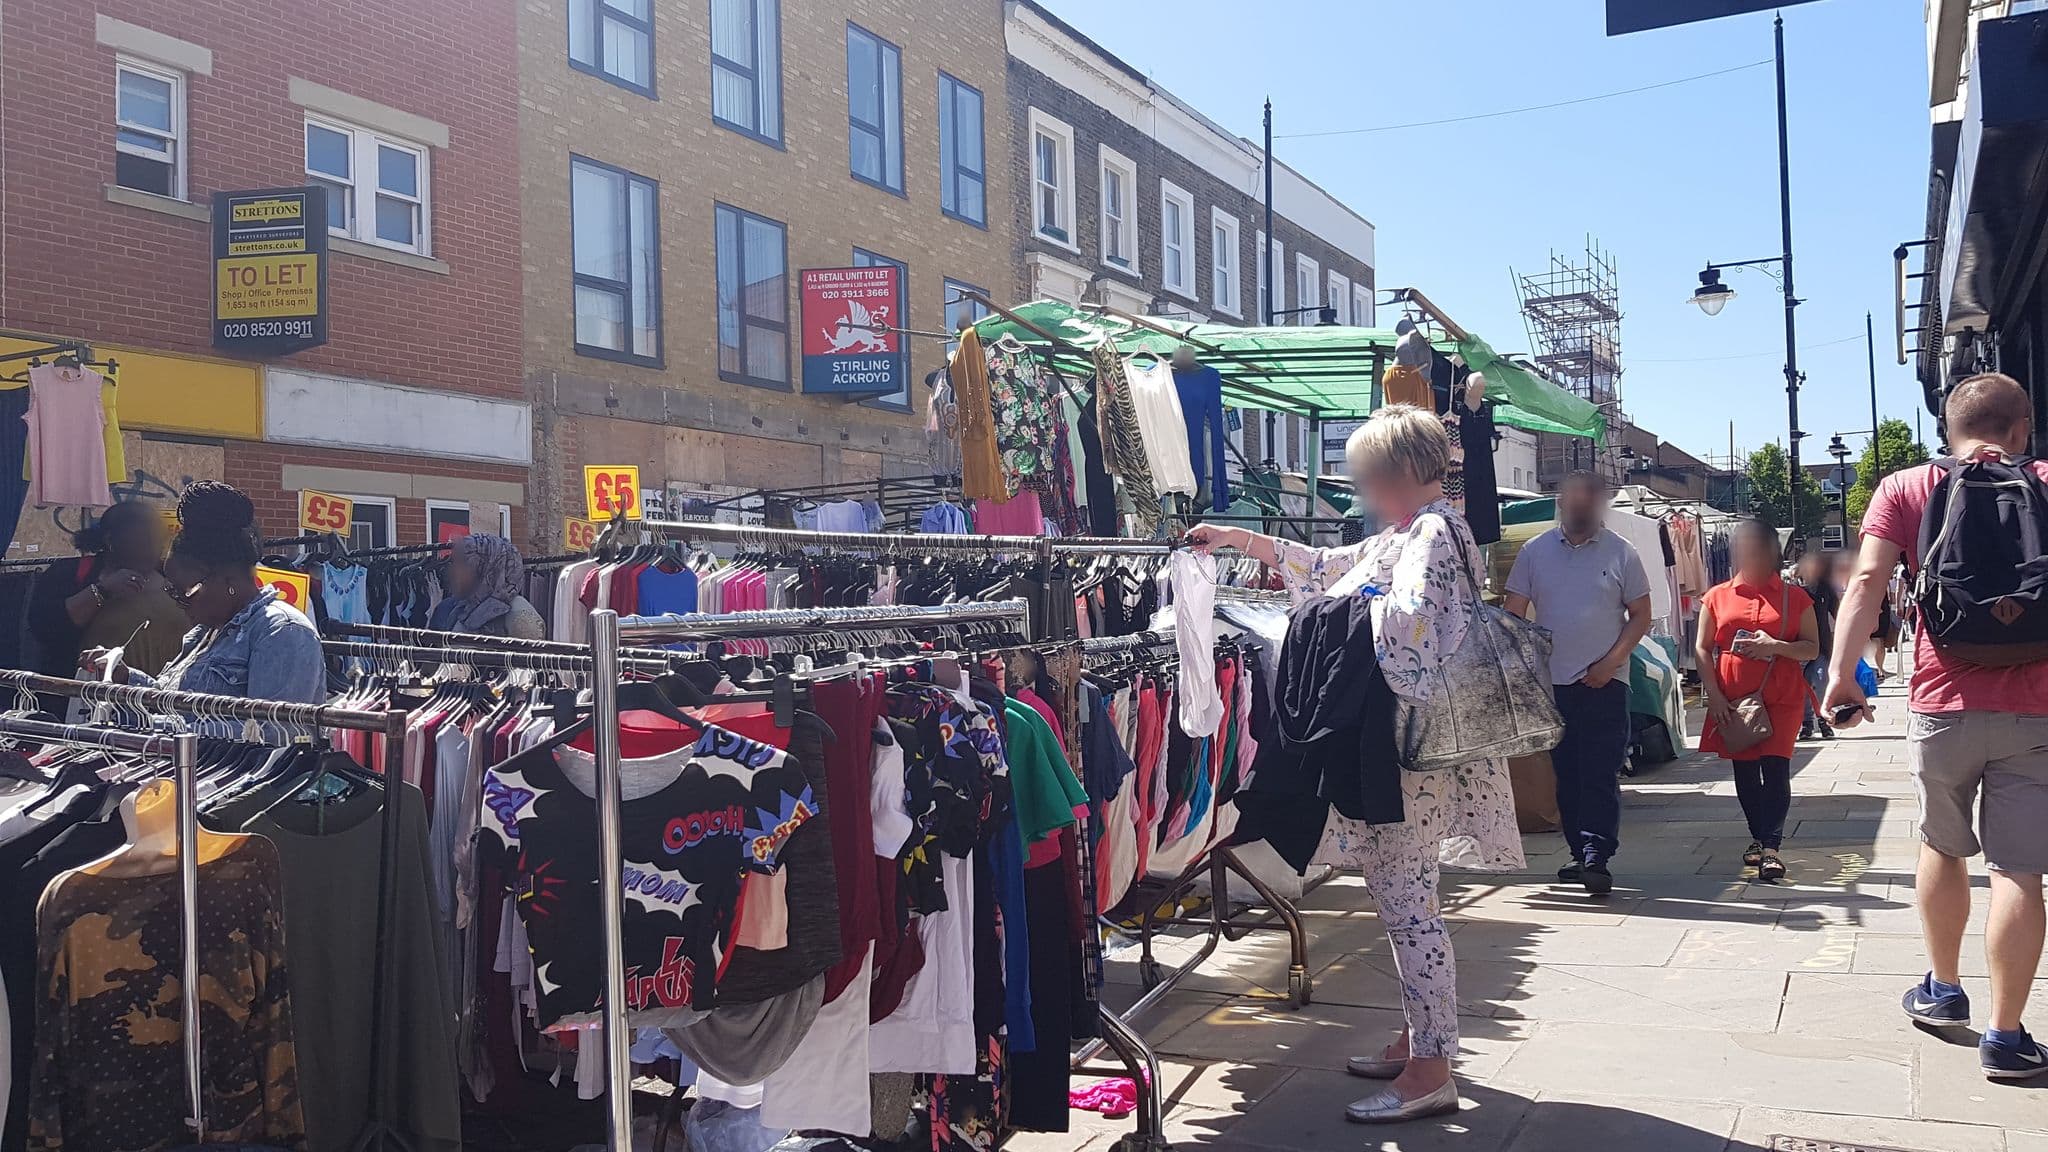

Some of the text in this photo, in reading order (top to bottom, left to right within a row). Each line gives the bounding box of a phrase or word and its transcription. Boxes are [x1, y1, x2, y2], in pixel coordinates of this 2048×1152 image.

[235, 205, 298, 218] STRETTONS
[234, 241, 298, 252] strettons.co.uk
[227, 263, 307, 287] TO LET
[807, 270, 889, 282] A1 RETAIL UNIT TO LET
[221, 290, 242, 299] Shop
[248, 289, 271, 297] Office
[276, 287, 313, 296] Premises
[822, 288, 889, 299] 020 3911 3666
[248, 302, 258, 310] sq
[260, 300, 266, 308] ft
[285, 299, 296, 307] sq
[298, 298, 308, 307] m)
[224, 320, 312, 338] 020 8520 9911
[832, 360, 890, 372] STIRLING
[832, 372, 890, 384] ACKROYD
[595, 472, 634, 512] £5
[308, 496, 346, 528] £5
[568, 521, 595, 547] £6
